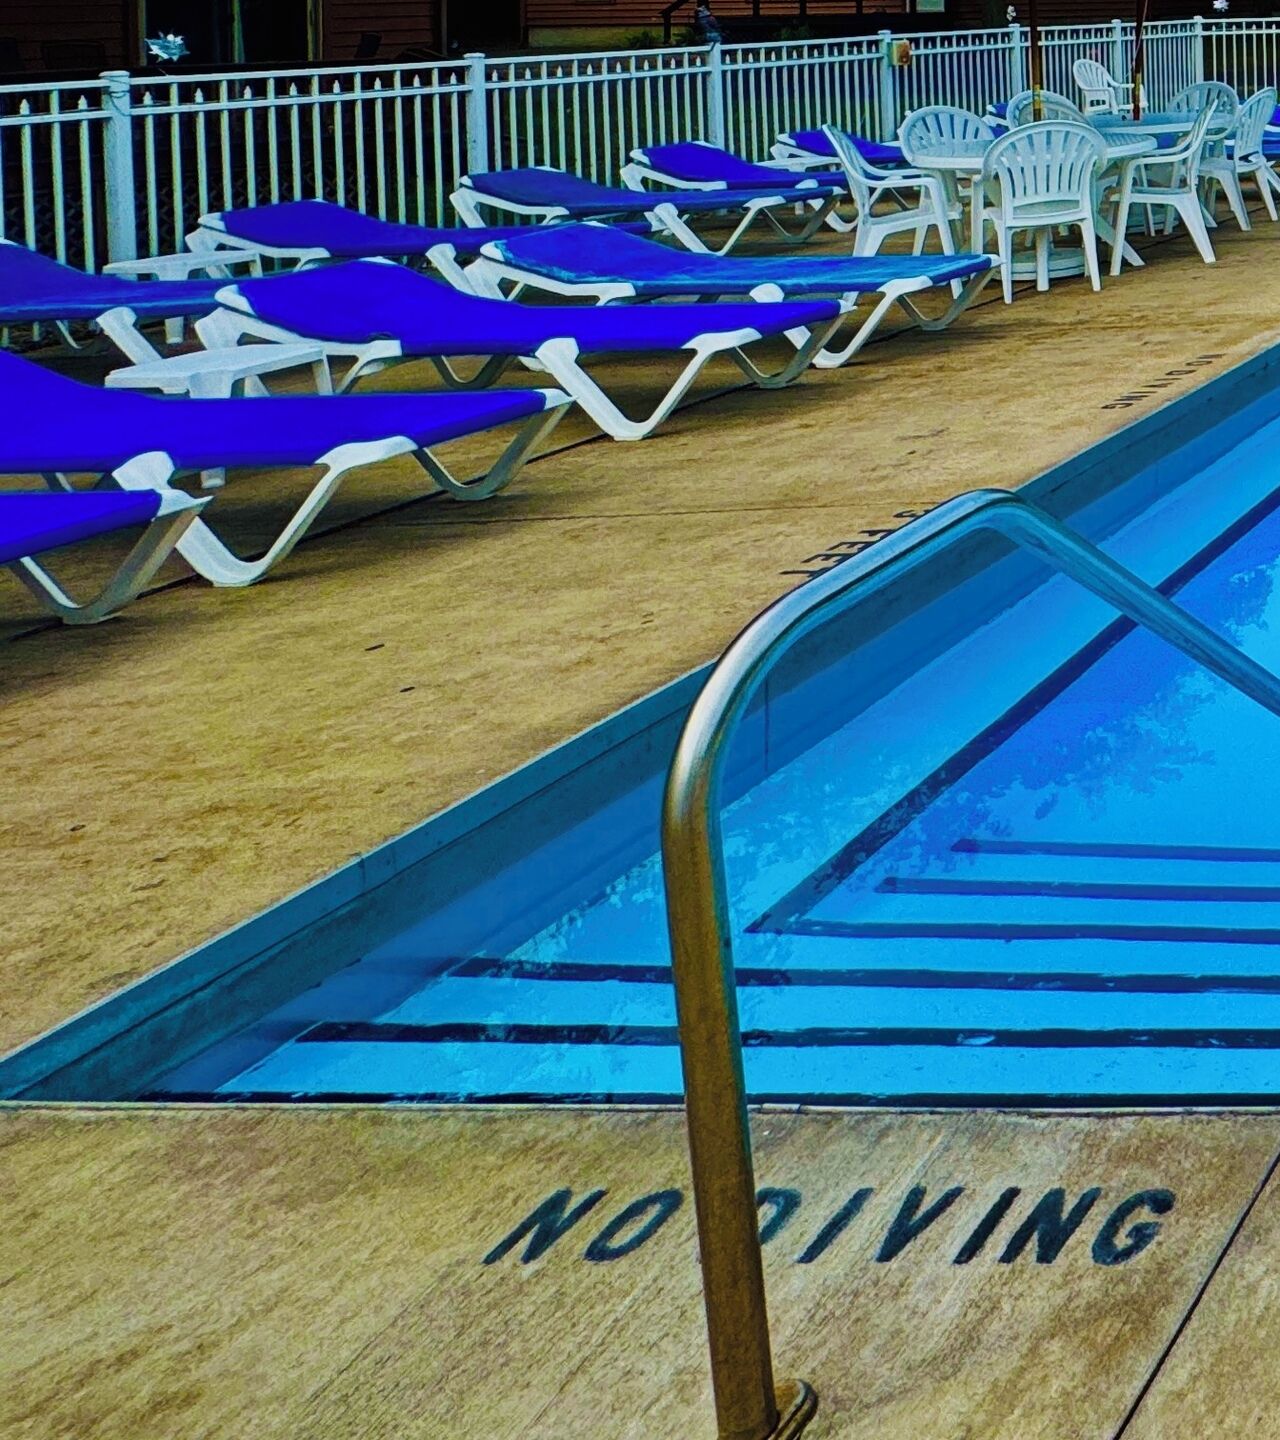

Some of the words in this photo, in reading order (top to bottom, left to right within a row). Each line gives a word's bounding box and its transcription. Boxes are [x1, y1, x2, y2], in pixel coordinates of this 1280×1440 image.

[1185, 353, 1228, 367] NO
[1101, 369, 1198, 410] DIVING
[482, 1186, 683, 1266] NO
